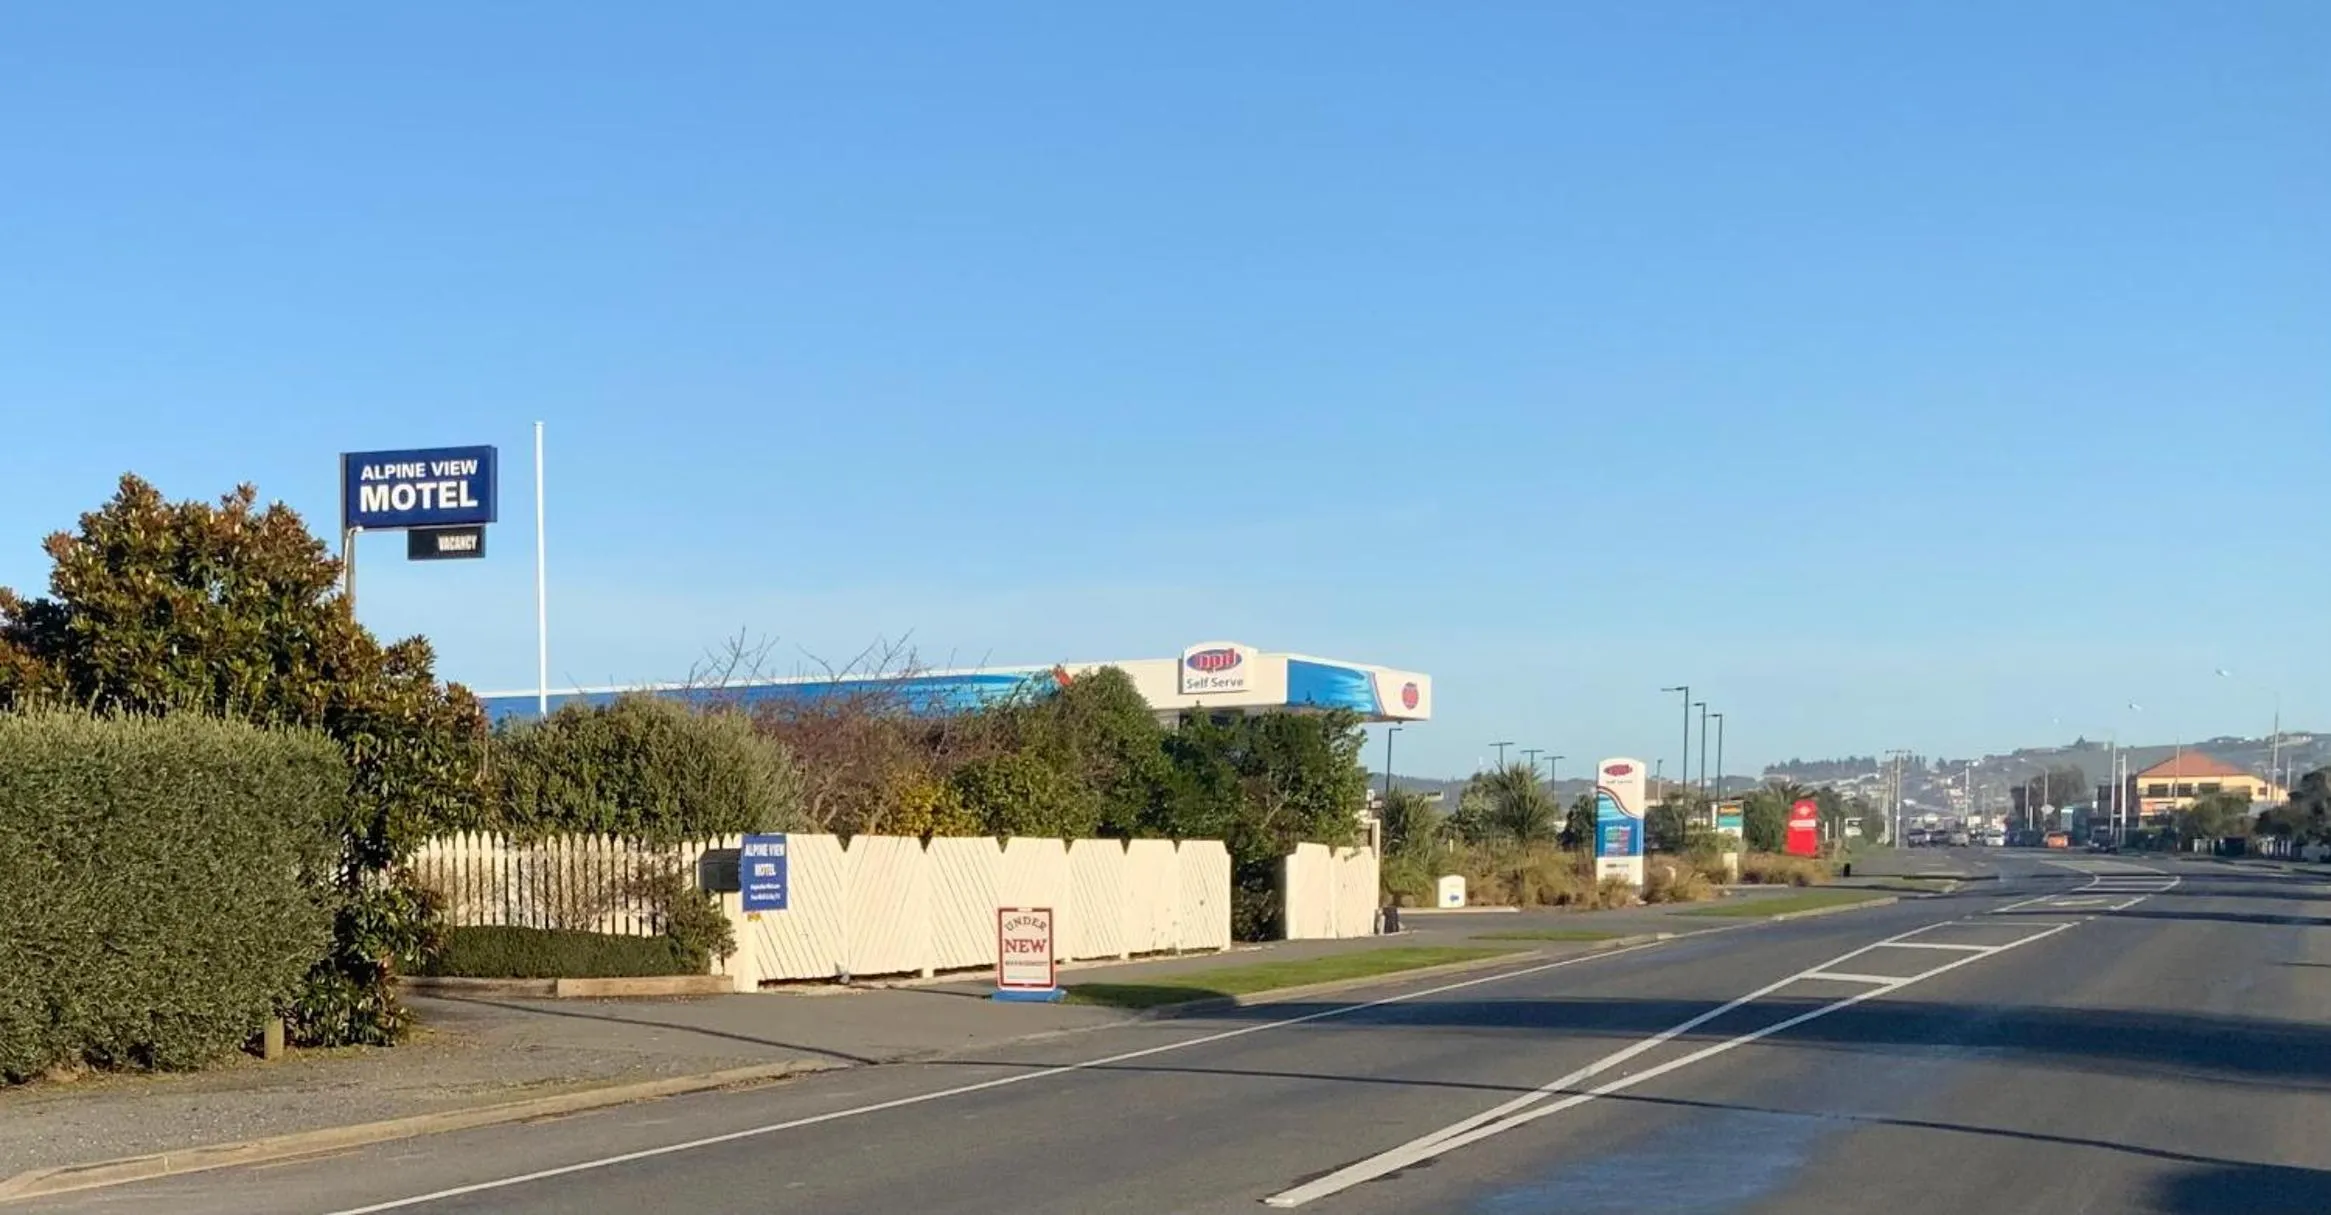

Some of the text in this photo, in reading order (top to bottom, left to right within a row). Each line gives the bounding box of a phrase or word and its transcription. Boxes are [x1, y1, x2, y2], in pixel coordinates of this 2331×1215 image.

[361, 459, 478, 480] ALPINE VIEW
[360, 481, 478, 512] MOTEL
[438, 535, 477, 551] VACANCY
[1186, 677, 1244, 689] Self Serve
[744, 843, 785, 856] ALPINE VIEW
[1005, 916, 1047, 931] UNDER
[1005, 939, 1047, 953] NEW
